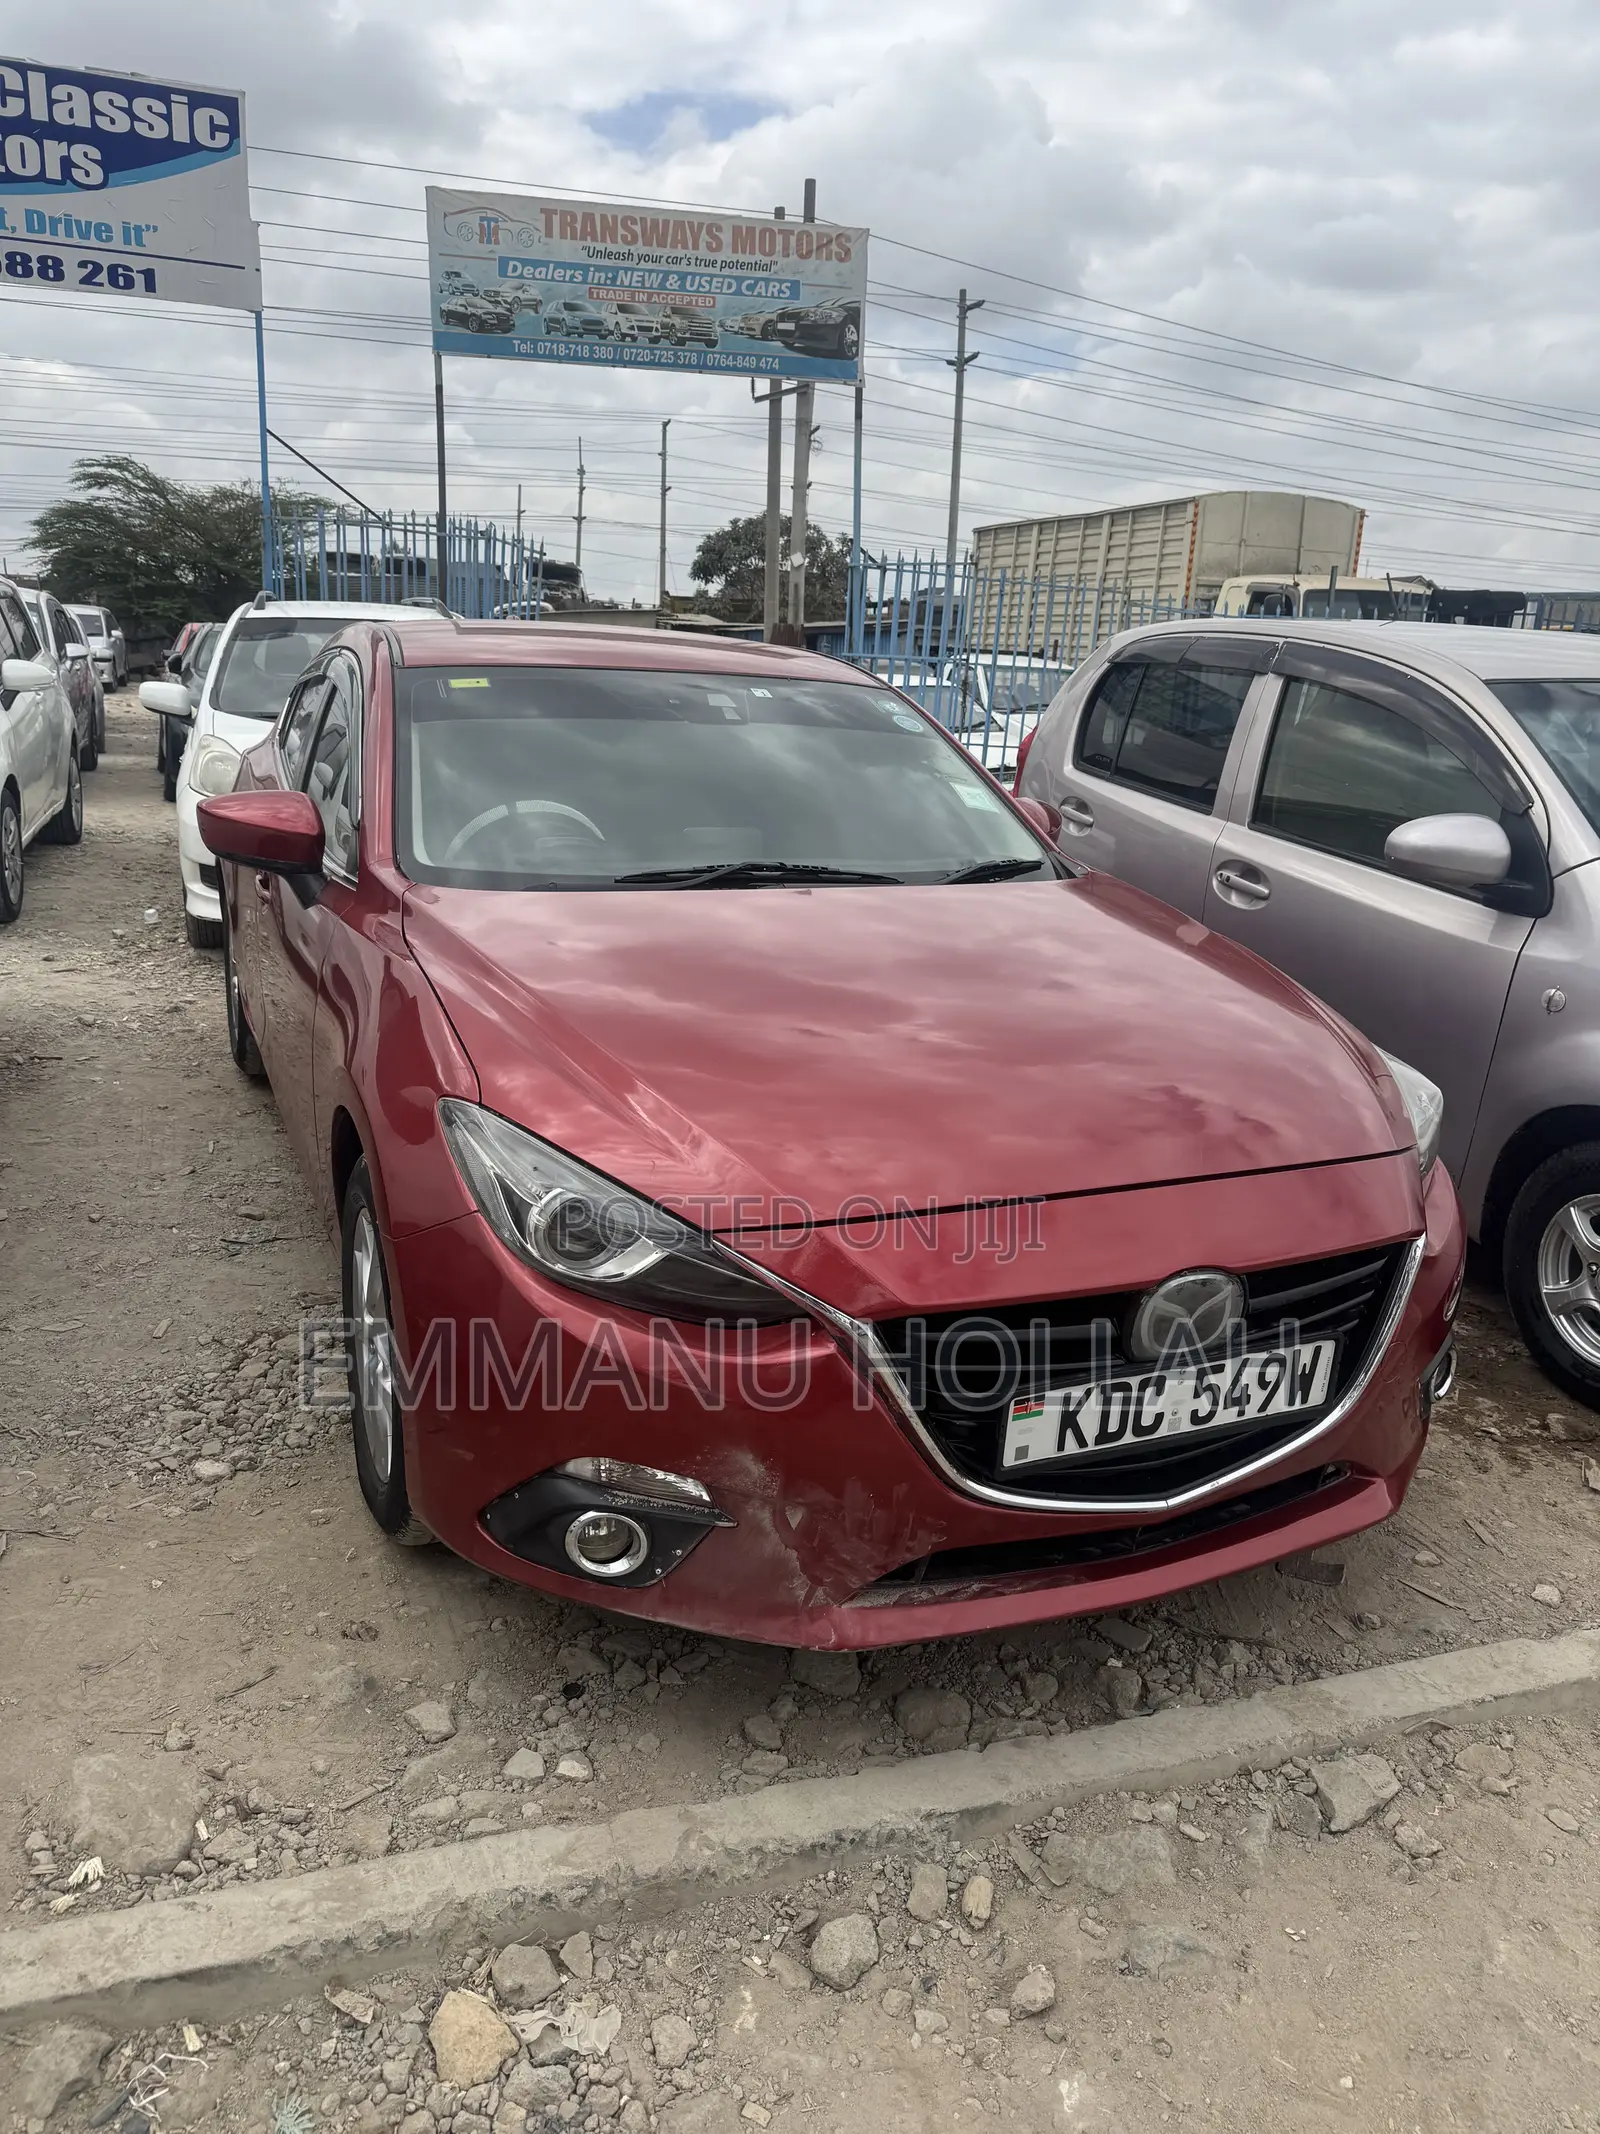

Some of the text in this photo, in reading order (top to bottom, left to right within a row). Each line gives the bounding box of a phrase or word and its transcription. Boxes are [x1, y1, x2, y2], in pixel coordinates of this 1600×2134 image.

[0, 65, 230, 149] Classic
[0, 134, 104, 186] ors
[25, 208, 114, 243] Drive
[540, 208, 852, 263] TRANSWAYS MOTORS
[0, 251, 157, 294] 88 261
[507, 260, 792, 298] Dealers in: NEW & USED CARS
[636, 251, 664, 266] your
[665, 253, 692, 267] car's
[694, 256, 718, 269] true
[591, 289, 714, 307] TRADE IN ACCEPTED
[513, 340, 534, 354] Tel:
[537, 341, 590, 358] 0718-718
[593, 346, 614, 359] 380
[623, 348, 674, 363] 0720-725
[677, 351, 698, 365] 378
[706, 353, 756, 369] 0764-849
[759, 357, 780, 370] 474
[1056, 1373, 1168, 1453] KDC
[1190, 1344, 1323, 1427] 549W
